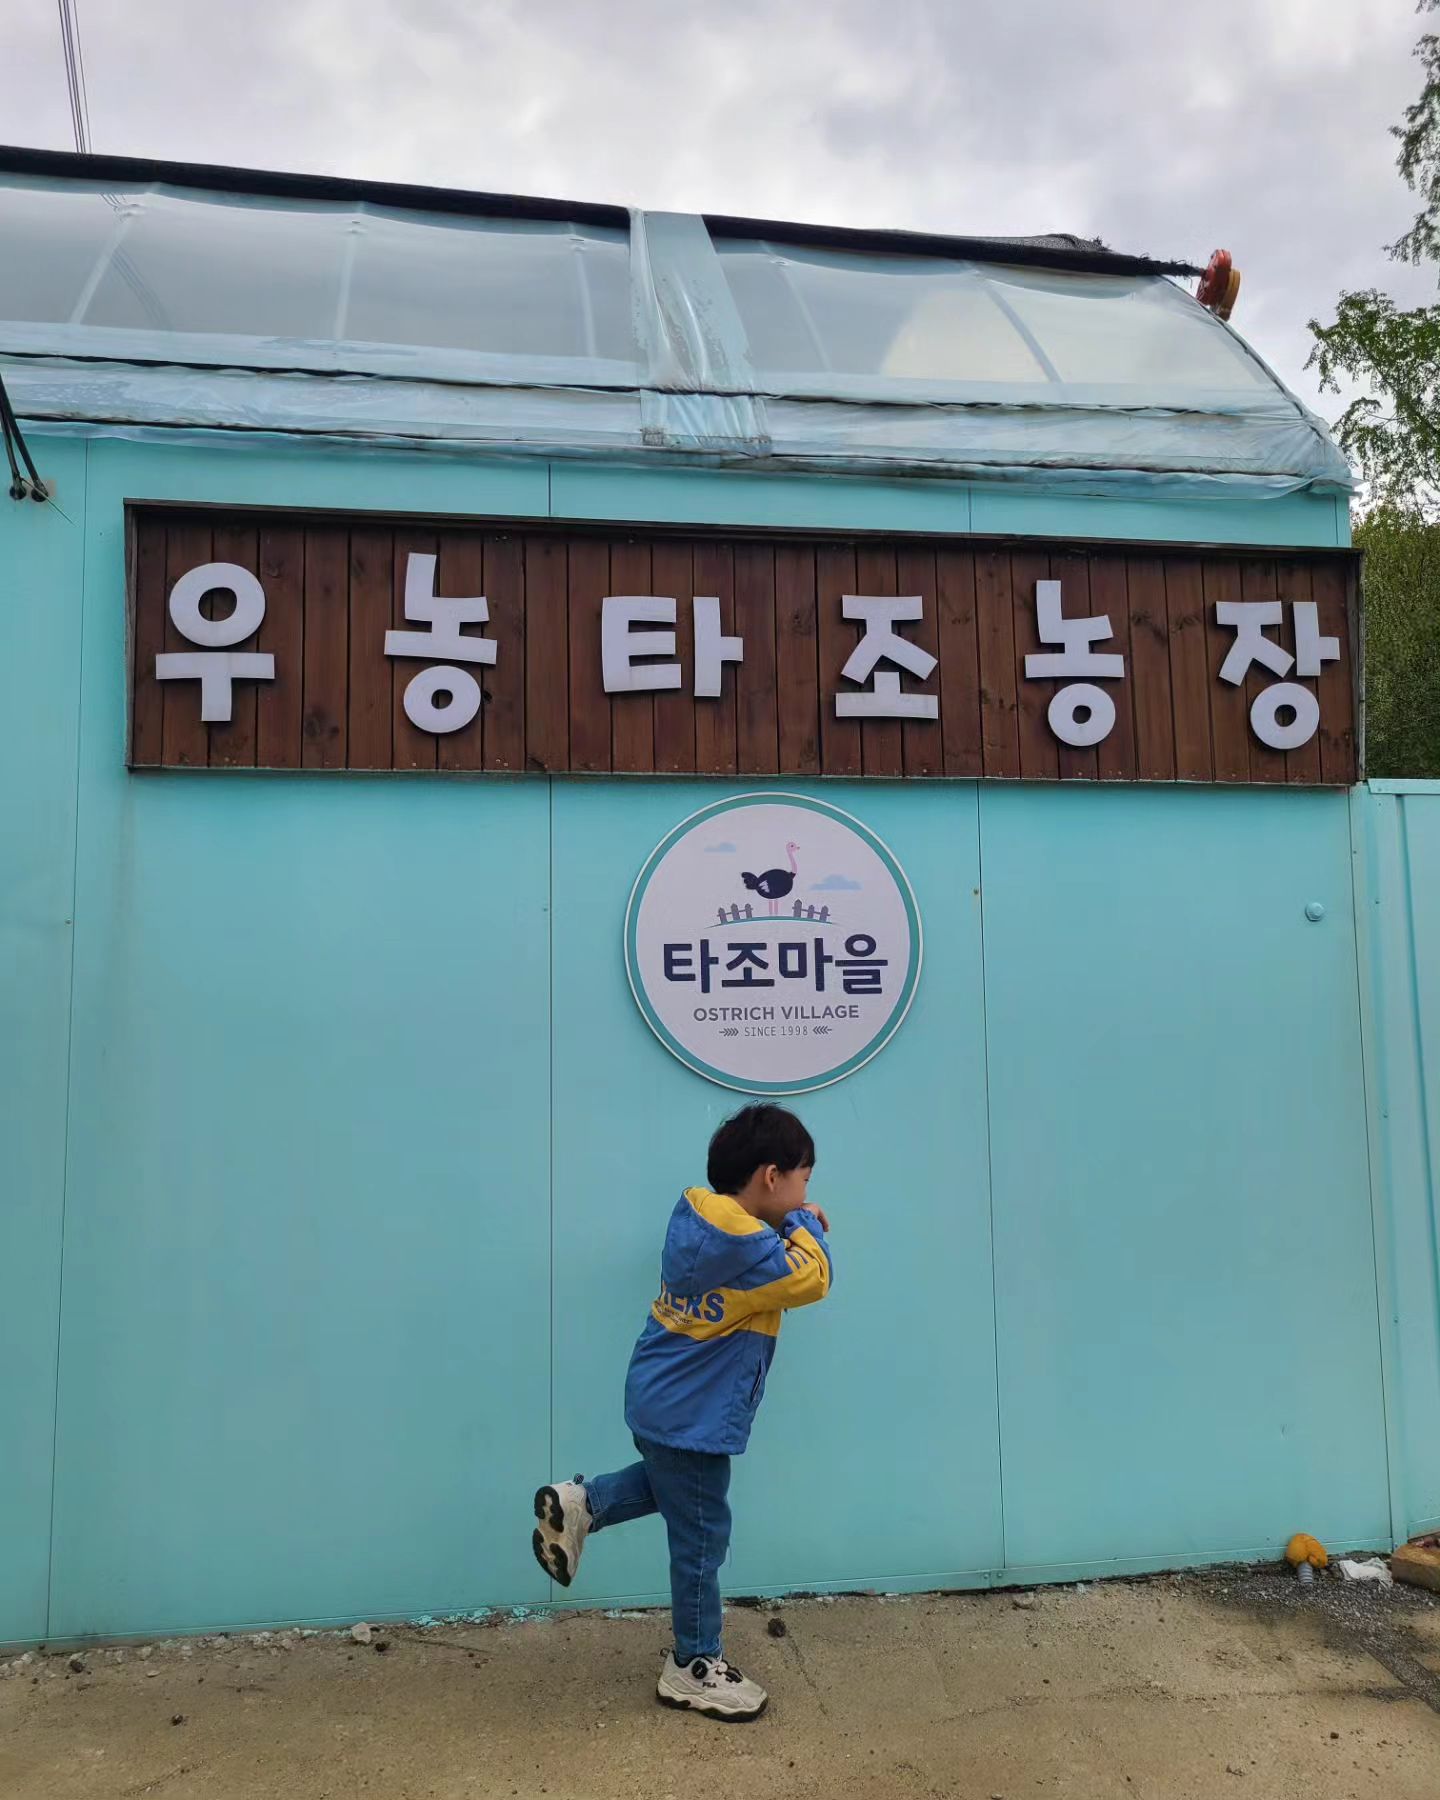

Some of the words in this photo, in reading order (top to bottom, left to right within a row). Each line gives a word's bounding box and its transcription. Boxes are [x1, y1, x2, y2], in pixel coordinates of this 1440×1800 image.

[156, 552, 1341, 749] 우농타조농장
[663, 933, 889, 995] 타조마을
[693, 1005, 775, 1022] OSTRICH
[781, 1004, 860, 1020] VILLAGE
[744, 1026, 777, 1037] SINCE
[781, 1025, 809, 1037] 1998
